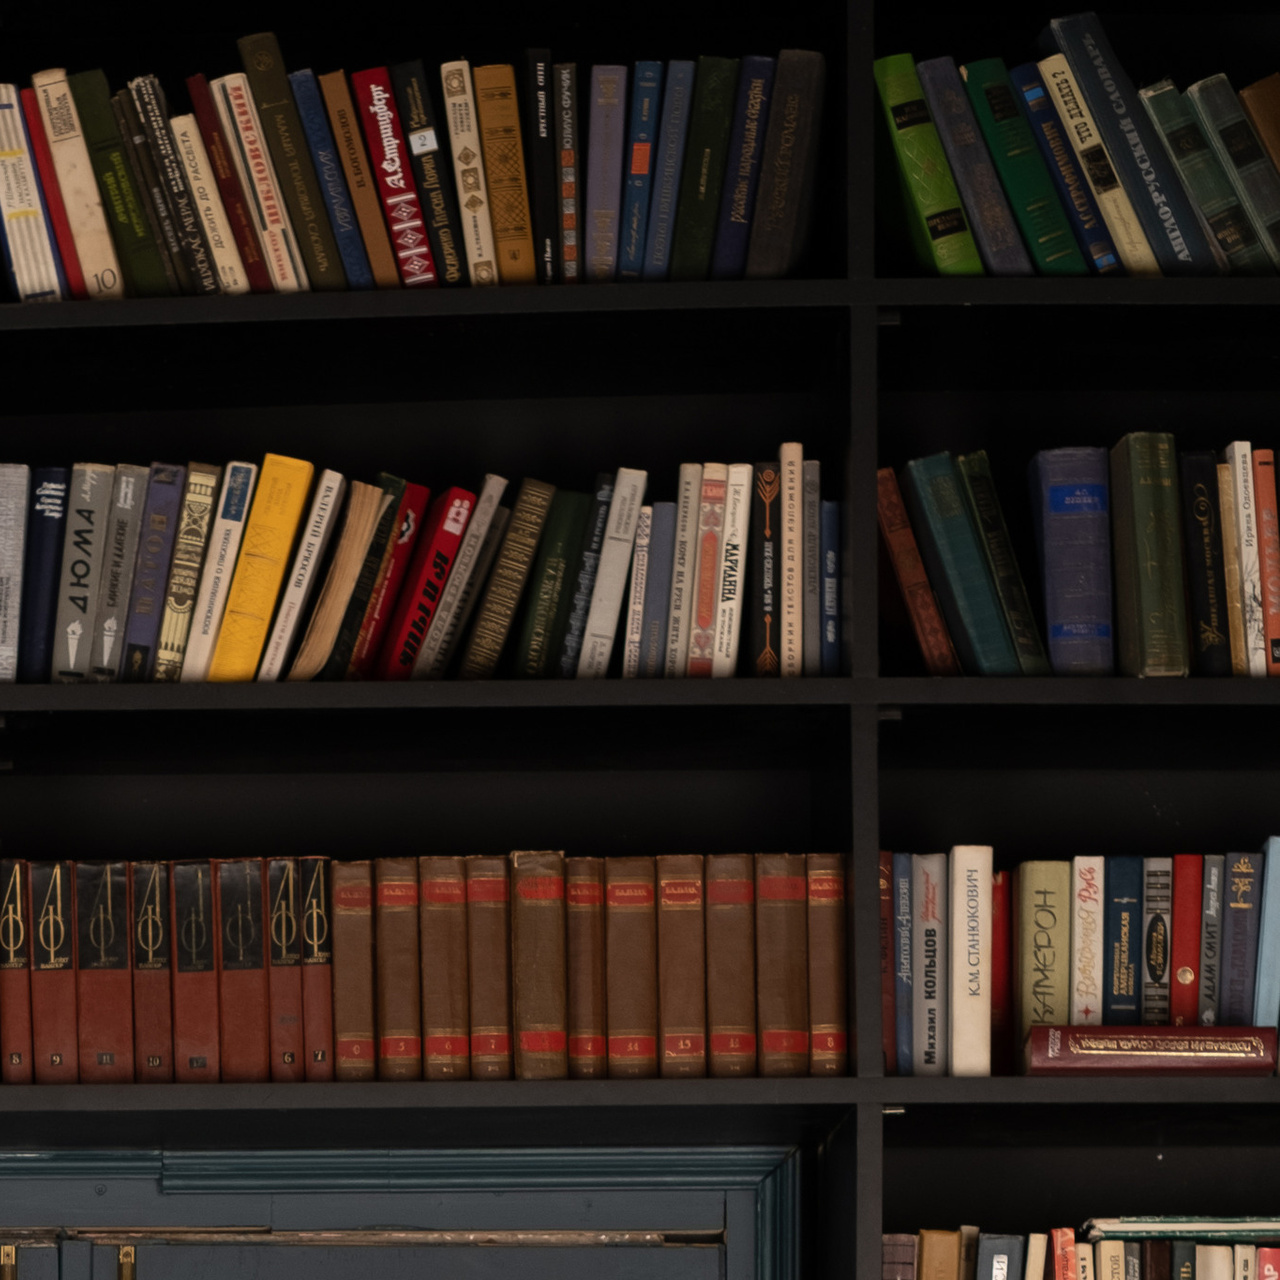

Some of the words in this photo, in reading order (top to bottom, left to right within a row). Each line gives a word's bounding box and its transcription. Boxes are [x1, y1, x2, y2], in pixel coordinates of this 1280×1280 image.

[1082, 34, 1125, 116] СЛОВАРЬ
[1056, 82, 1085, 121] ДЕЛАТЬ
[338, 108, 364, 176] БОГОМОЛОВ
[560, 109, 574, 150] ЮЛИУС
[1073, 124, 1093, 145] ЧТО
[179, 130, 203, 181] РАССВЕТА
[229, 85, 282, 225] ШКЛОВСКИЙ
[421, 154, 440, 189] Лорка
[196, 185, 210, 201] ДО
[275, 114, 295, 157] МАЛЫЙ
[288, 159, 317, 220] ТОЛКОВЫЙ
[308, 223, 330, 271] СЛОВАРЬ
[429, 190, 449, 227] Гарсиа
[204, 205, 226, 249] ДОЖИТЬ
[437, 229, 461, 283] Федерико
[92, 268, 117, 294] 10
[308, 485, 334, 538] ВАЛЕРИЙ
[786, 460, 796, 532] ИЗЛОЖЕНИЙ
[677, 539, 688, 563] КОМУ
[1243, 512, 1253, 548] Ирина
[68, 507, 95, 614] ДЮМА
[292, 542, 315, 589] БРЮСОВ
[675, 570, 686, 585] НА
[720, 542, 740, 603] МАРИАННА
[674, 588, 685, 610] РУСИ
[787, 566, 796, 615] ТЕКСТОВ
[670, 616, 681, 641] ЖИТЬ
[966, 868, 980, 966] СТАНЮКОВИЧ
[1031, 888, 1057, 1025] КАМЕРОН
[1204, 920, 1218, 959] СМИТ
[924, 927, 937, 1000] КОЛЬЦОВ
[1204, 959, 1216, 1002] АДАМ
[924, 1007, 937, 1065] Михаил
[11, 1055, 19, 1065] 8
[51, 1055, 60, 1065] 9
[147, 1057, 159, 1067] 10
[283, 1053, 291, 1064] 6
